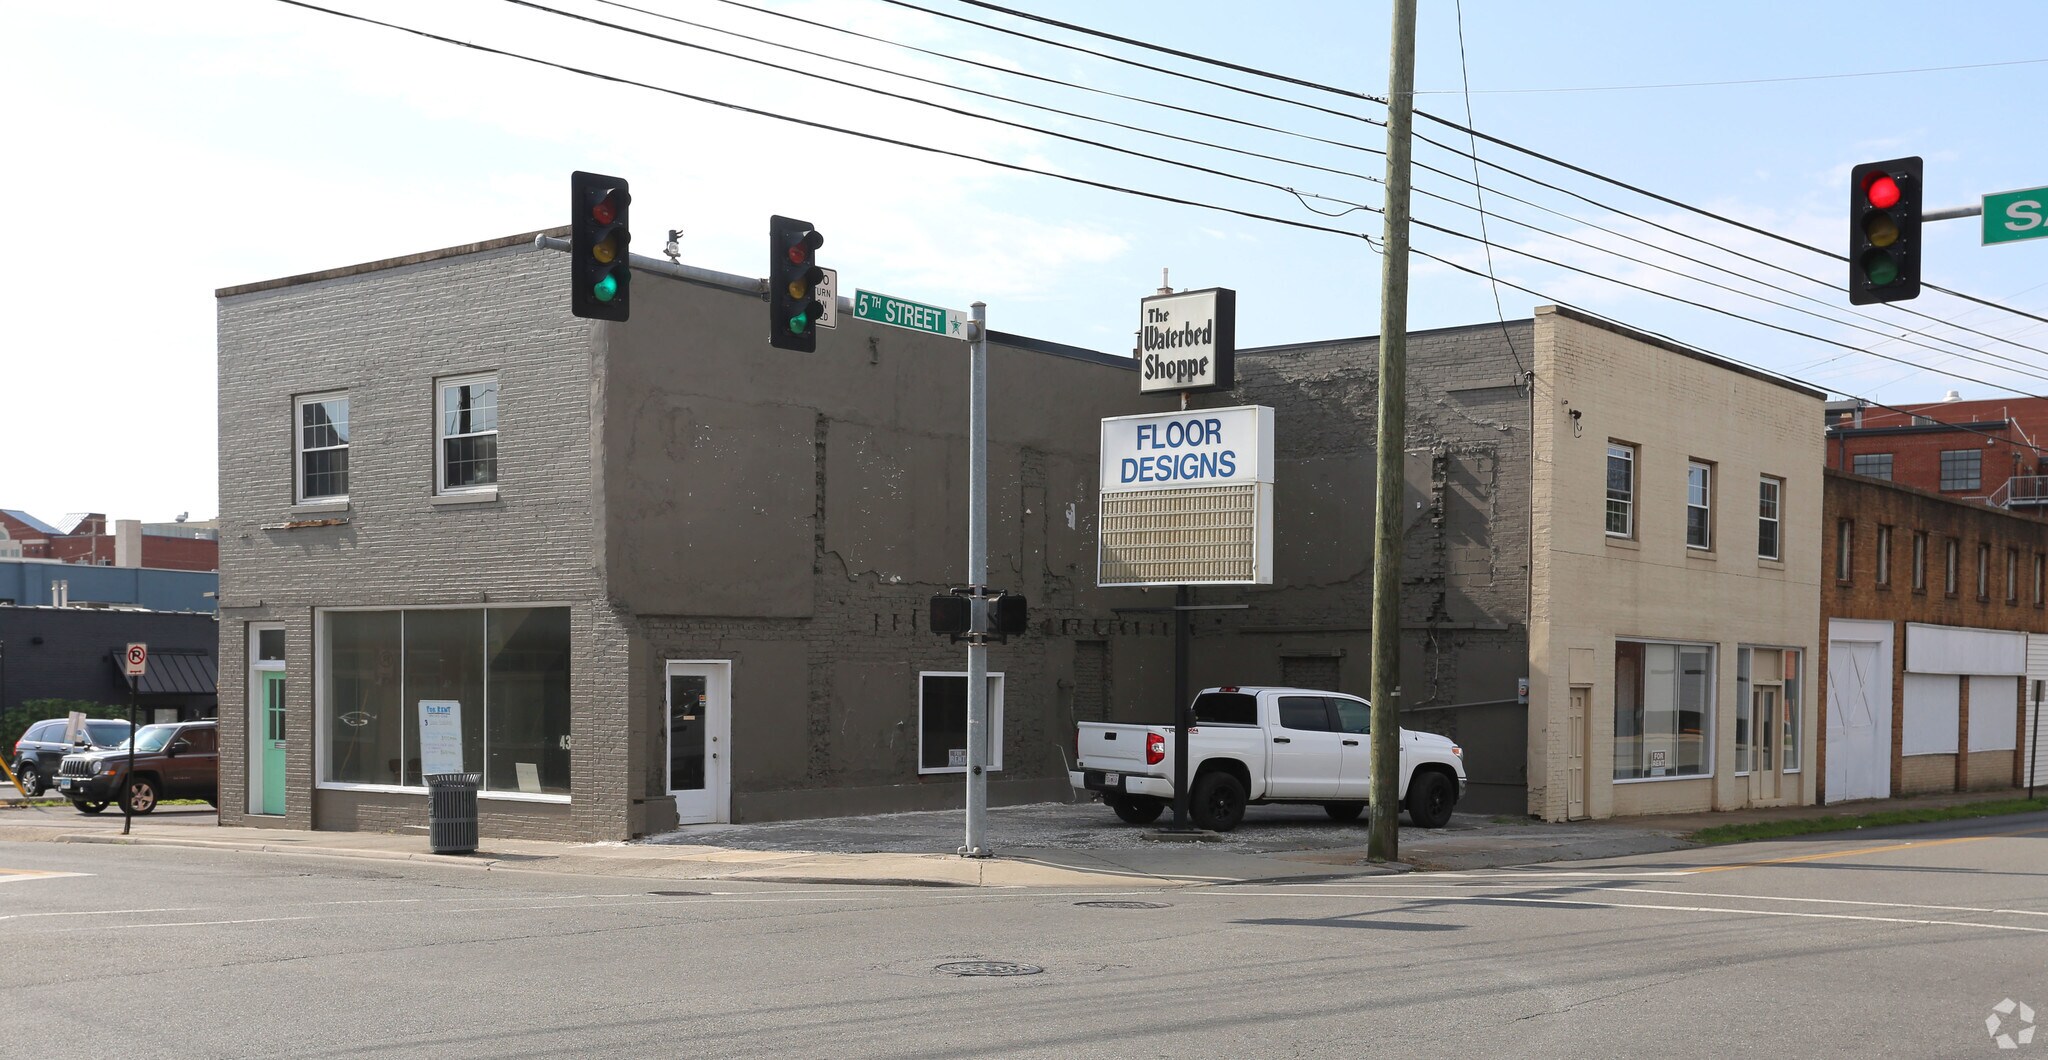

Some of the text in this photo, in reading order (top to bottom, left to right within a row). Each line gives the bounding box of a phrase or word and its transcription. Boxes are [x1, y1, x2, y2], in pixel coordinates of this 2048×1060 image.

[2004, 200, 2048, 231] S
[815, 286, 831, 298] URN
[885, 300, 942, 331] STREET
[1148, 308, 1170, 323] The
[1144, 319, 1212, 352] Waterbed
[1144, 354, 1209, 383] Shoppe
[1137, 418, 1222, 450] FLOOR
[1121, 450, 1236, 483] DESIGNS
[1653, 752, 1664, 760] FOR
